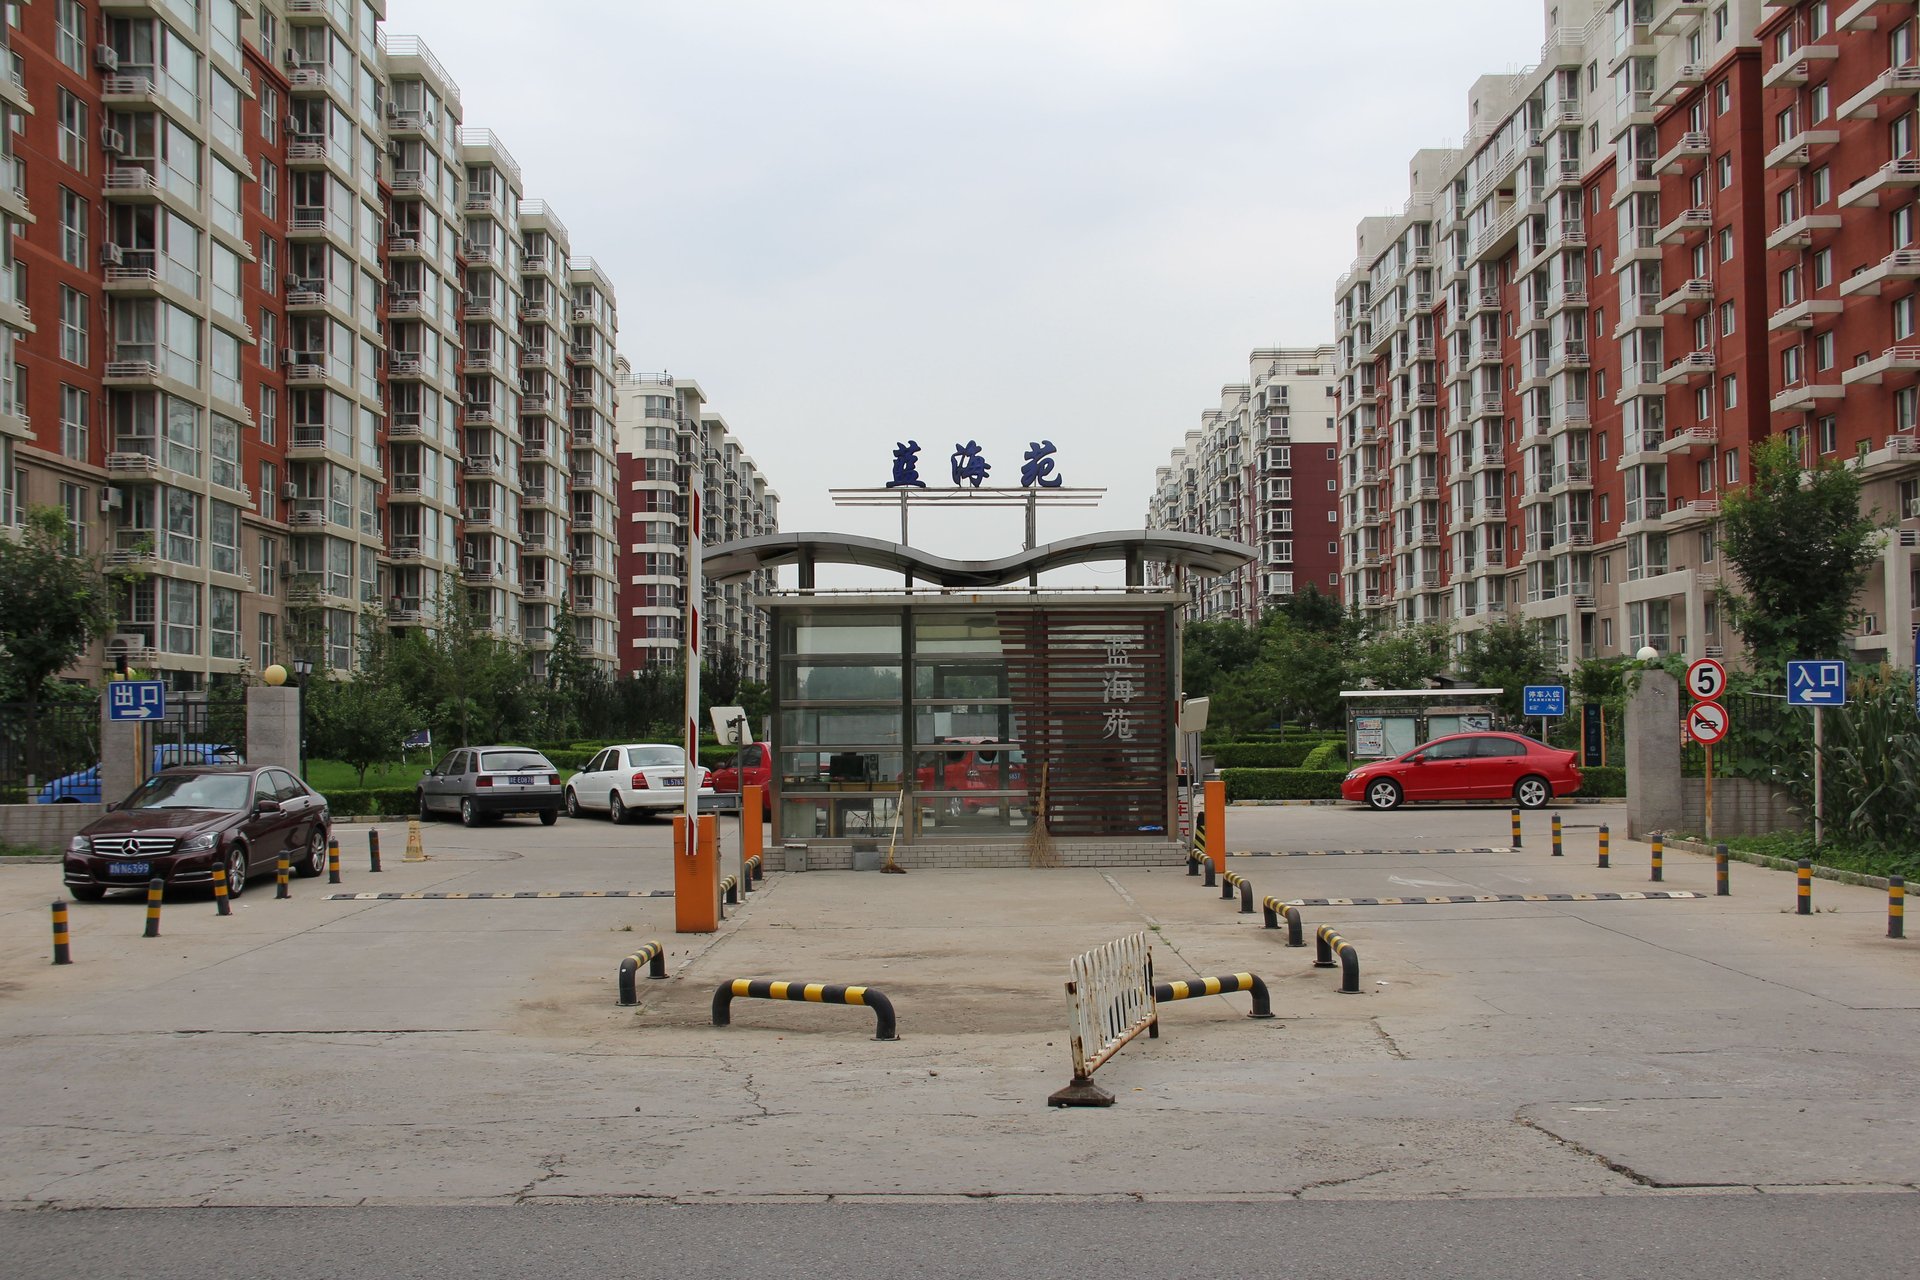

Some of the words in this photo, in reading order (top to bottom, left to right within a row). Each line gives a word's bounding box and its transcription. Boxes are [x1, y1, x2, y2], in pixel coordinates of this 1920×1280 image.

[886, 440, 1062, 488] 蓝海苑
[1102, 635, 1135, 740] 蓝海苑
[1697, 667, 1715, 694] 5
[1793, 665, 1839, 687] 入口
[115, 685, 158, 706] 出口
